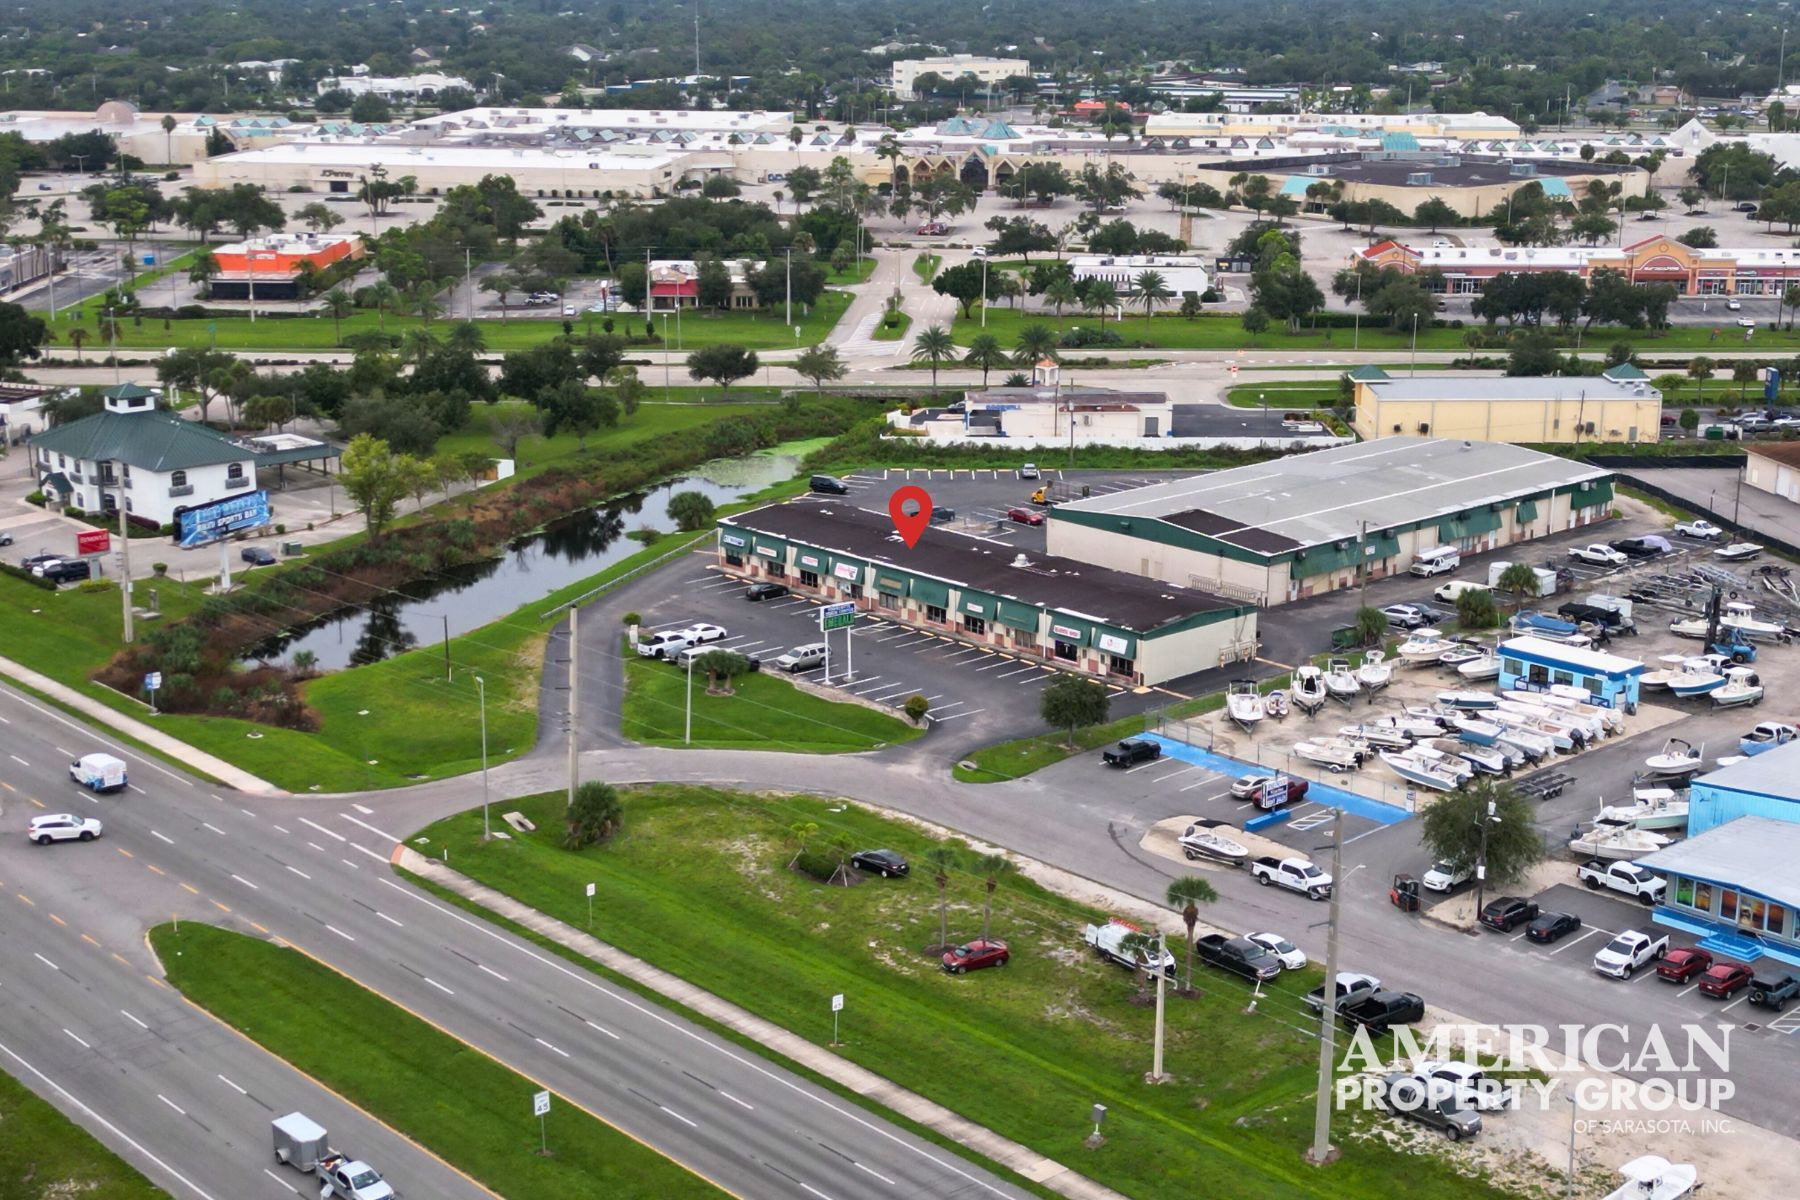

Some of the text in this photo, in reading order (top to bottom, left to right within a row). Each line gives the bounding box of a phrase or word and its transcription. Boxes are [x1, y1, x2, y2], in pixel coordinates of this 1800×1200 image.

[217, 512, 243, 527] SPORTS
[244, 508, 257, 519] BAR
[536, 1102, 549, 1112] 45
